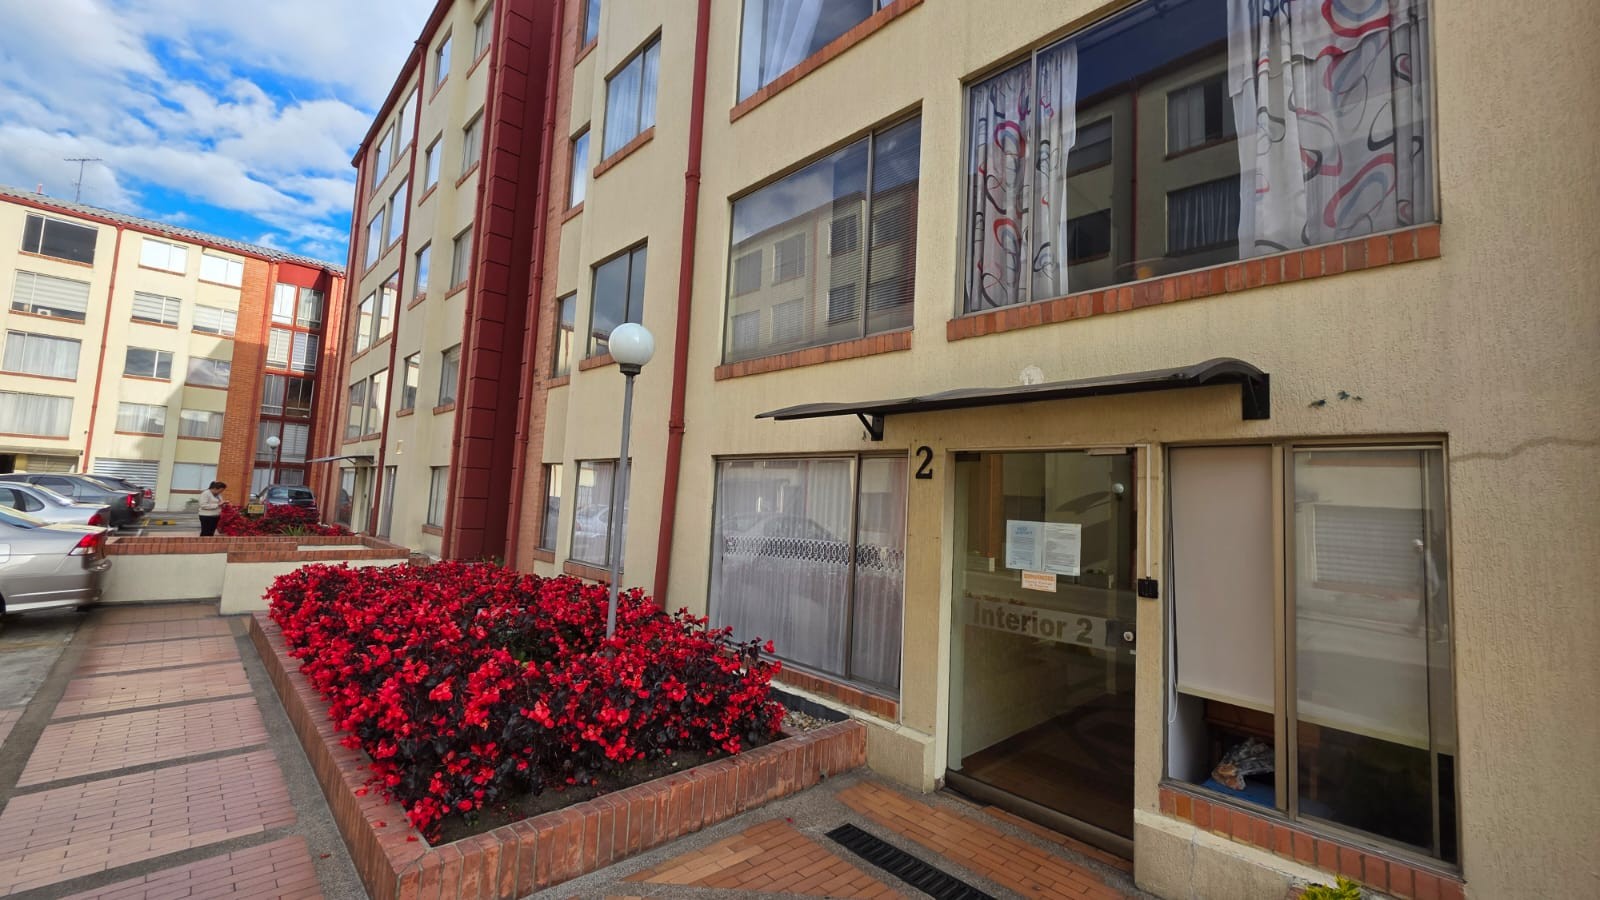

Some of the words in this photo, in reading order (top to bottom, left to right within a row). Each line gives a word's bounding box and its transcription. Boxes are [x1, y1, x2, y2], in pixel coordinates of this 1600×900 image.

[915, 445, 933, 480] 2
[973, 601, 1067, 640] Interior
[1075, 617, 1094, 645] 2
